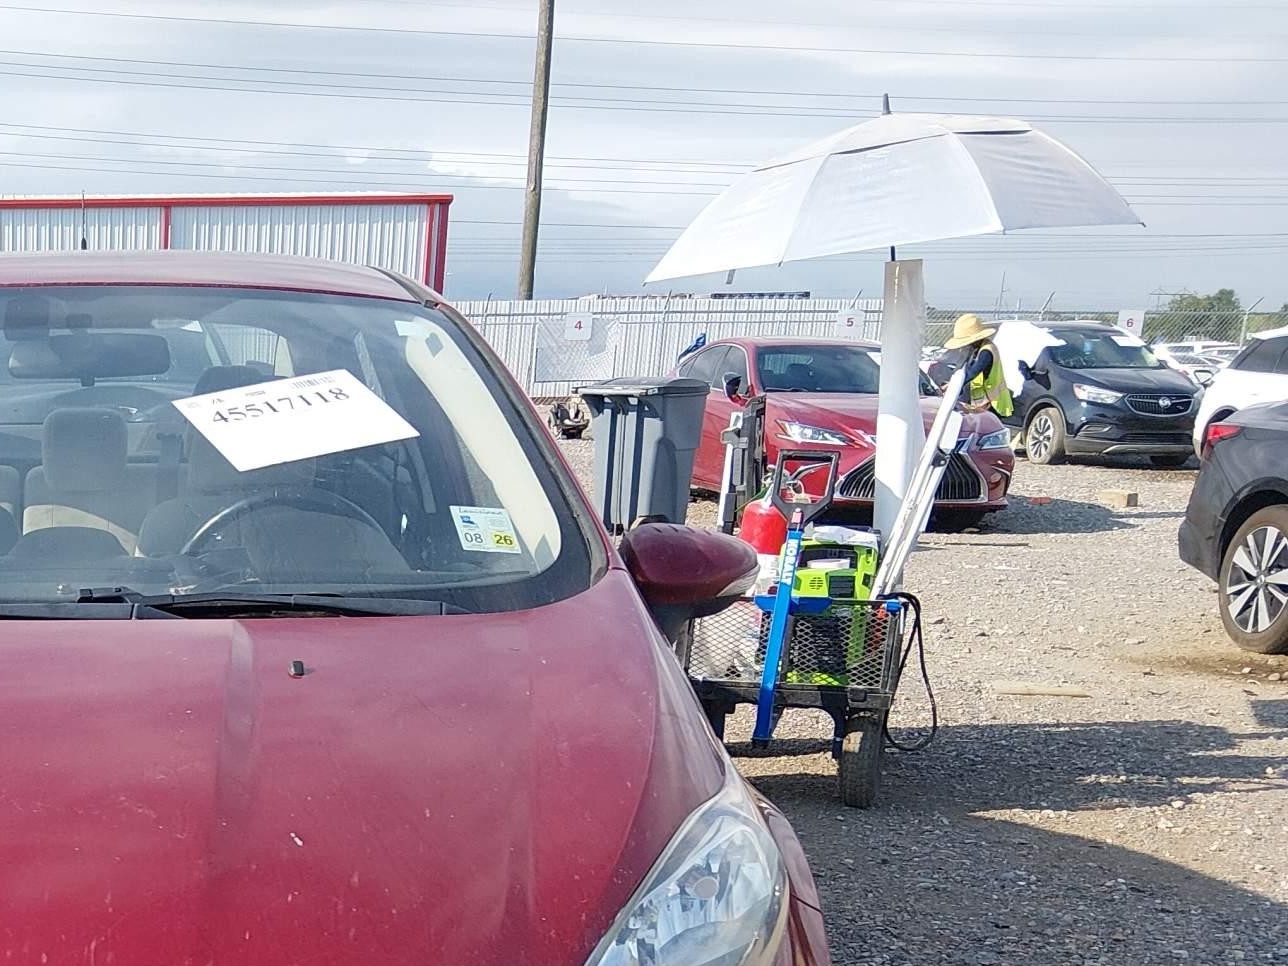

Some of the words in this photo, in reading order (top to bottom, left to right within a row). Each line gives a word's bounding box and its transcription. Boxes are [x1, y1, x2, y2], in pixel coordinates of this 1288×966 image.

[574, 320, 583, 330] 4
[846, 317, 855, 327] 5
[1126, 318, 1134, 328] 6
[212, 387, 350, 423] 45517118
[464, 532, 484, 543] 08
[494, 534, 513, 546] 26
